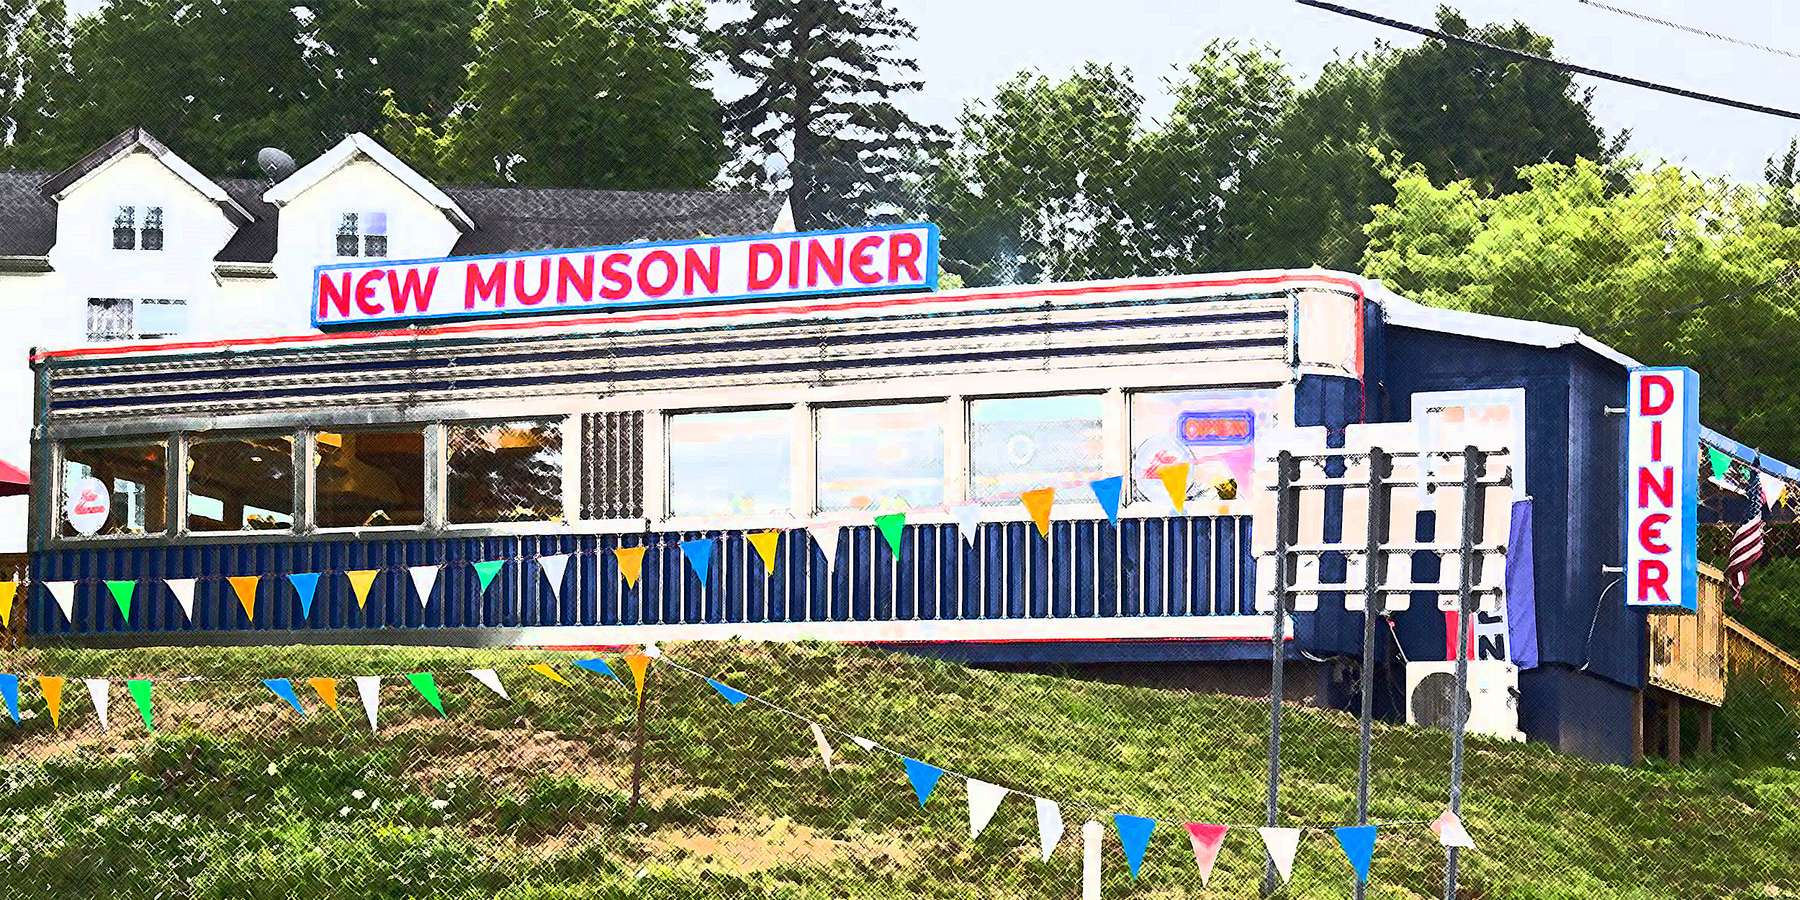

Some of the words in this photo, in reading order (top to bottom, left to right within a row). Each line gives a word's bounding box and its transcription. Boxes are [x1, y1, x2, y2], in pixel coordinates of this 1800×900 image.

[318, 267, 439, 317] NEW
[464, 246, 720, 308] MUNSON
[748, 232, 922, 291] DINER
[1638, 374, 1676, 603] DINER
